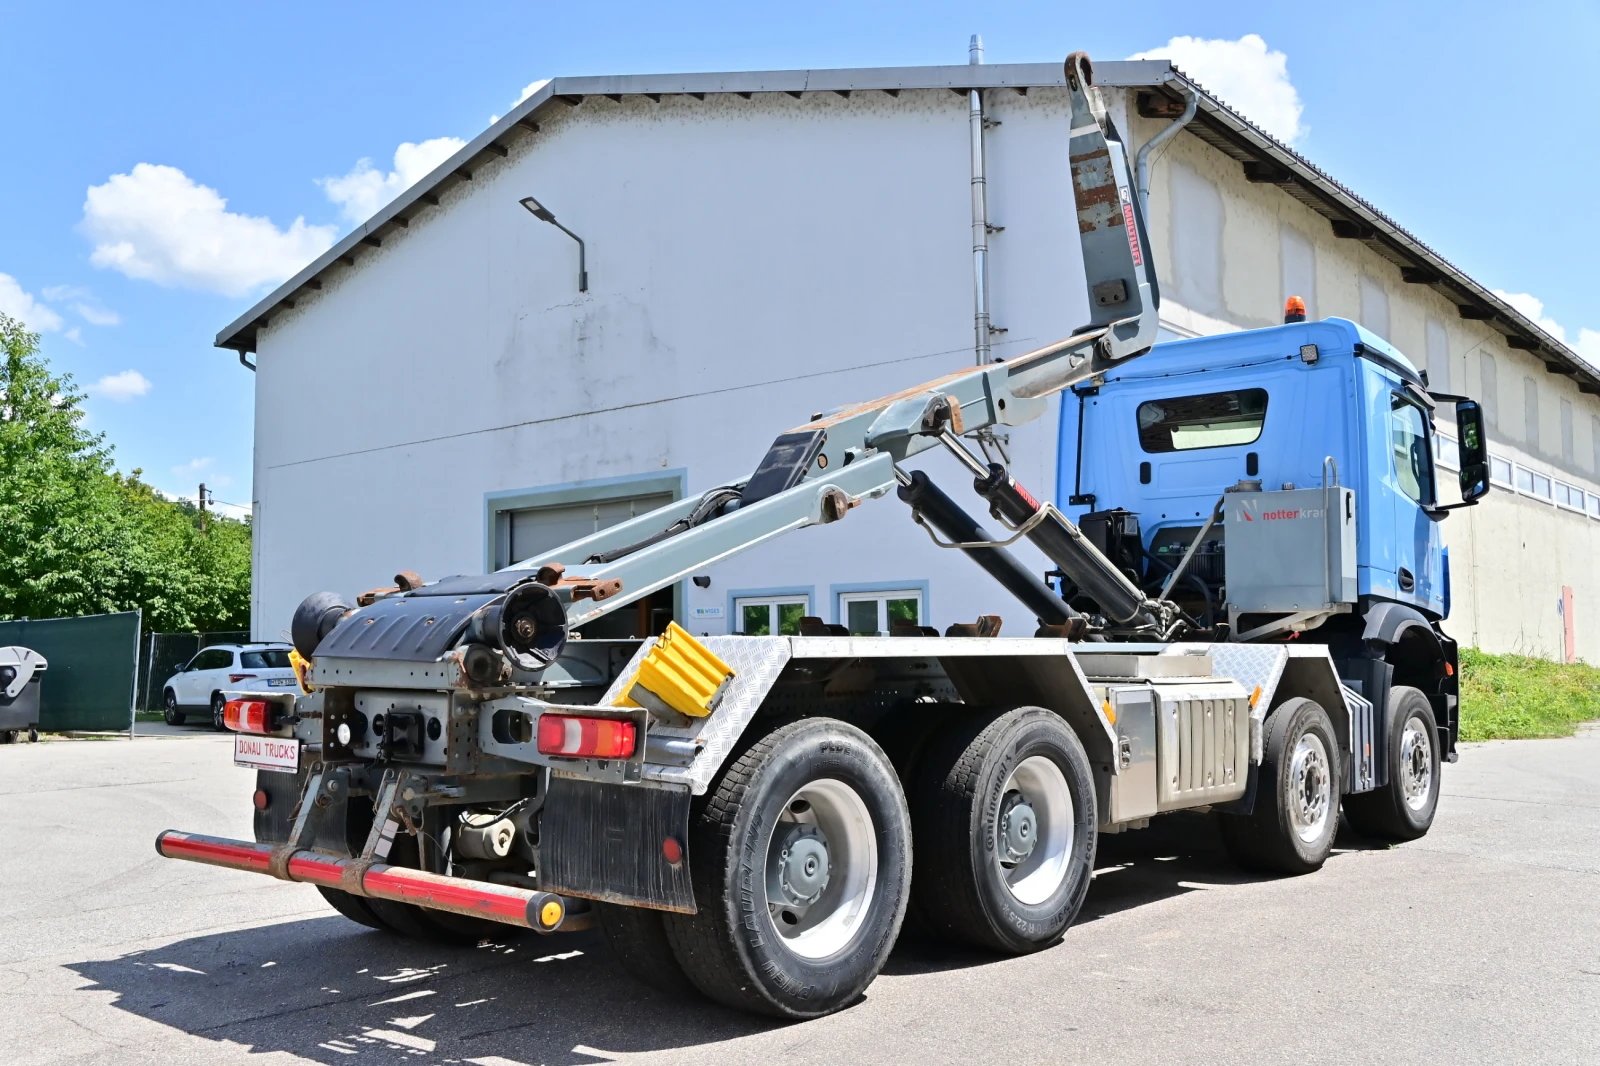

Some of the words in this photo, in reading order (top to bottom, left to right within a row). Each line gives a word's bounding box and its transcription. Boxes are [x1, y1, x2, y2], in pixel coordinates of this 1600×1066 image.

[1123, 204, 1142, 266] MULTILIFT
[239, 740, 261, 756] DONAU
[265, 743, 296, 760] TRUCKS
[986, 762, 1008, 852] Continental
[761, 959, 816, 1001] PNEU
